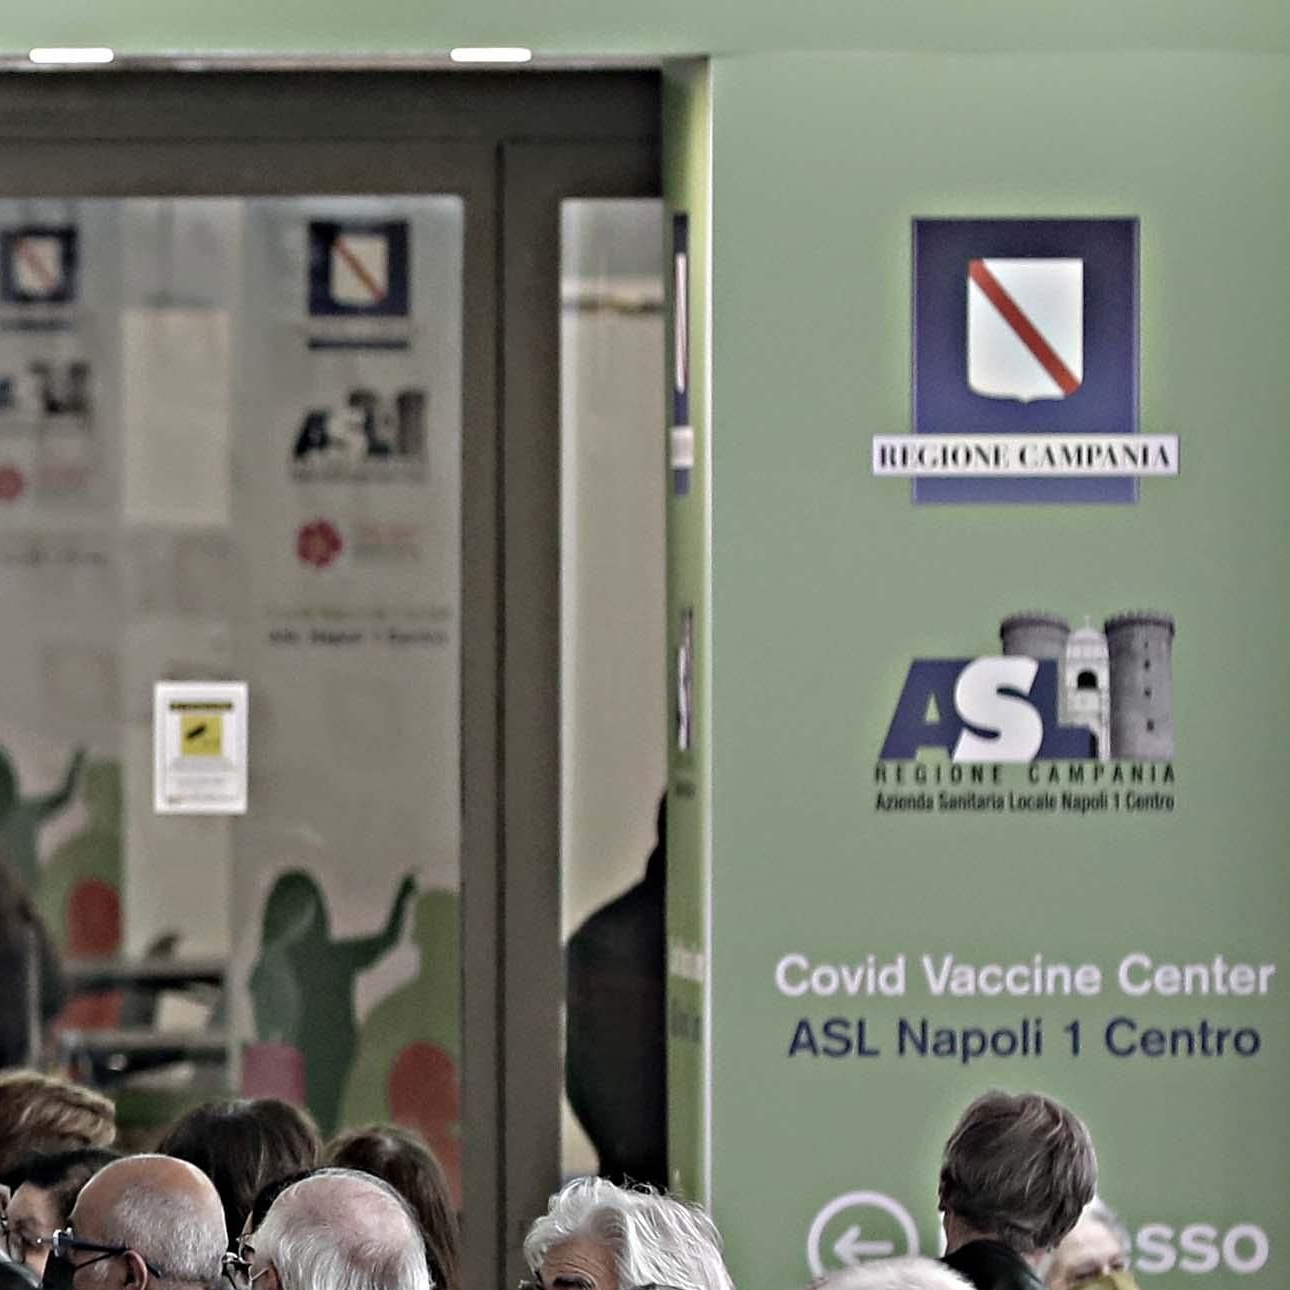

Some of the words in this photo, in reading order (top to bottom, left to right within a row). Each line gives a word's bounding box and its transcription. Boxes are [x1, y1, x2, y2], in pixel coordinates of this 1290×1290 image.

[880, 444, 1009, 468] REGIONE
[1019, 444, 1170, 468] CAMPANIA
[879, 656, 1098, 763] ASL
[875, 764, 1003, 784] REGIONE
[1028, 764, 1176, 784] CAMPANIA
[875, 793, 934, 812] Azienda
[938, 793, 1005, 812] Sanitaria
[1009, 793, 1058, 812] Locale
[1062, 793, 1109, 815] Napoli
[1125, 793, 1175, 812] Centro
[774, 953, 907, 997] Covid
[921, 953, 1102, 997] Vaccine
[1118, 953, 1277, 997] Center
[788, 1017, 880, 1059] ASL
[897, 1017, 1043, 1065] Napoli
[1064, 1019, 1080, 1058] 1
[1105, 1017, 1262, 1058] Centro
